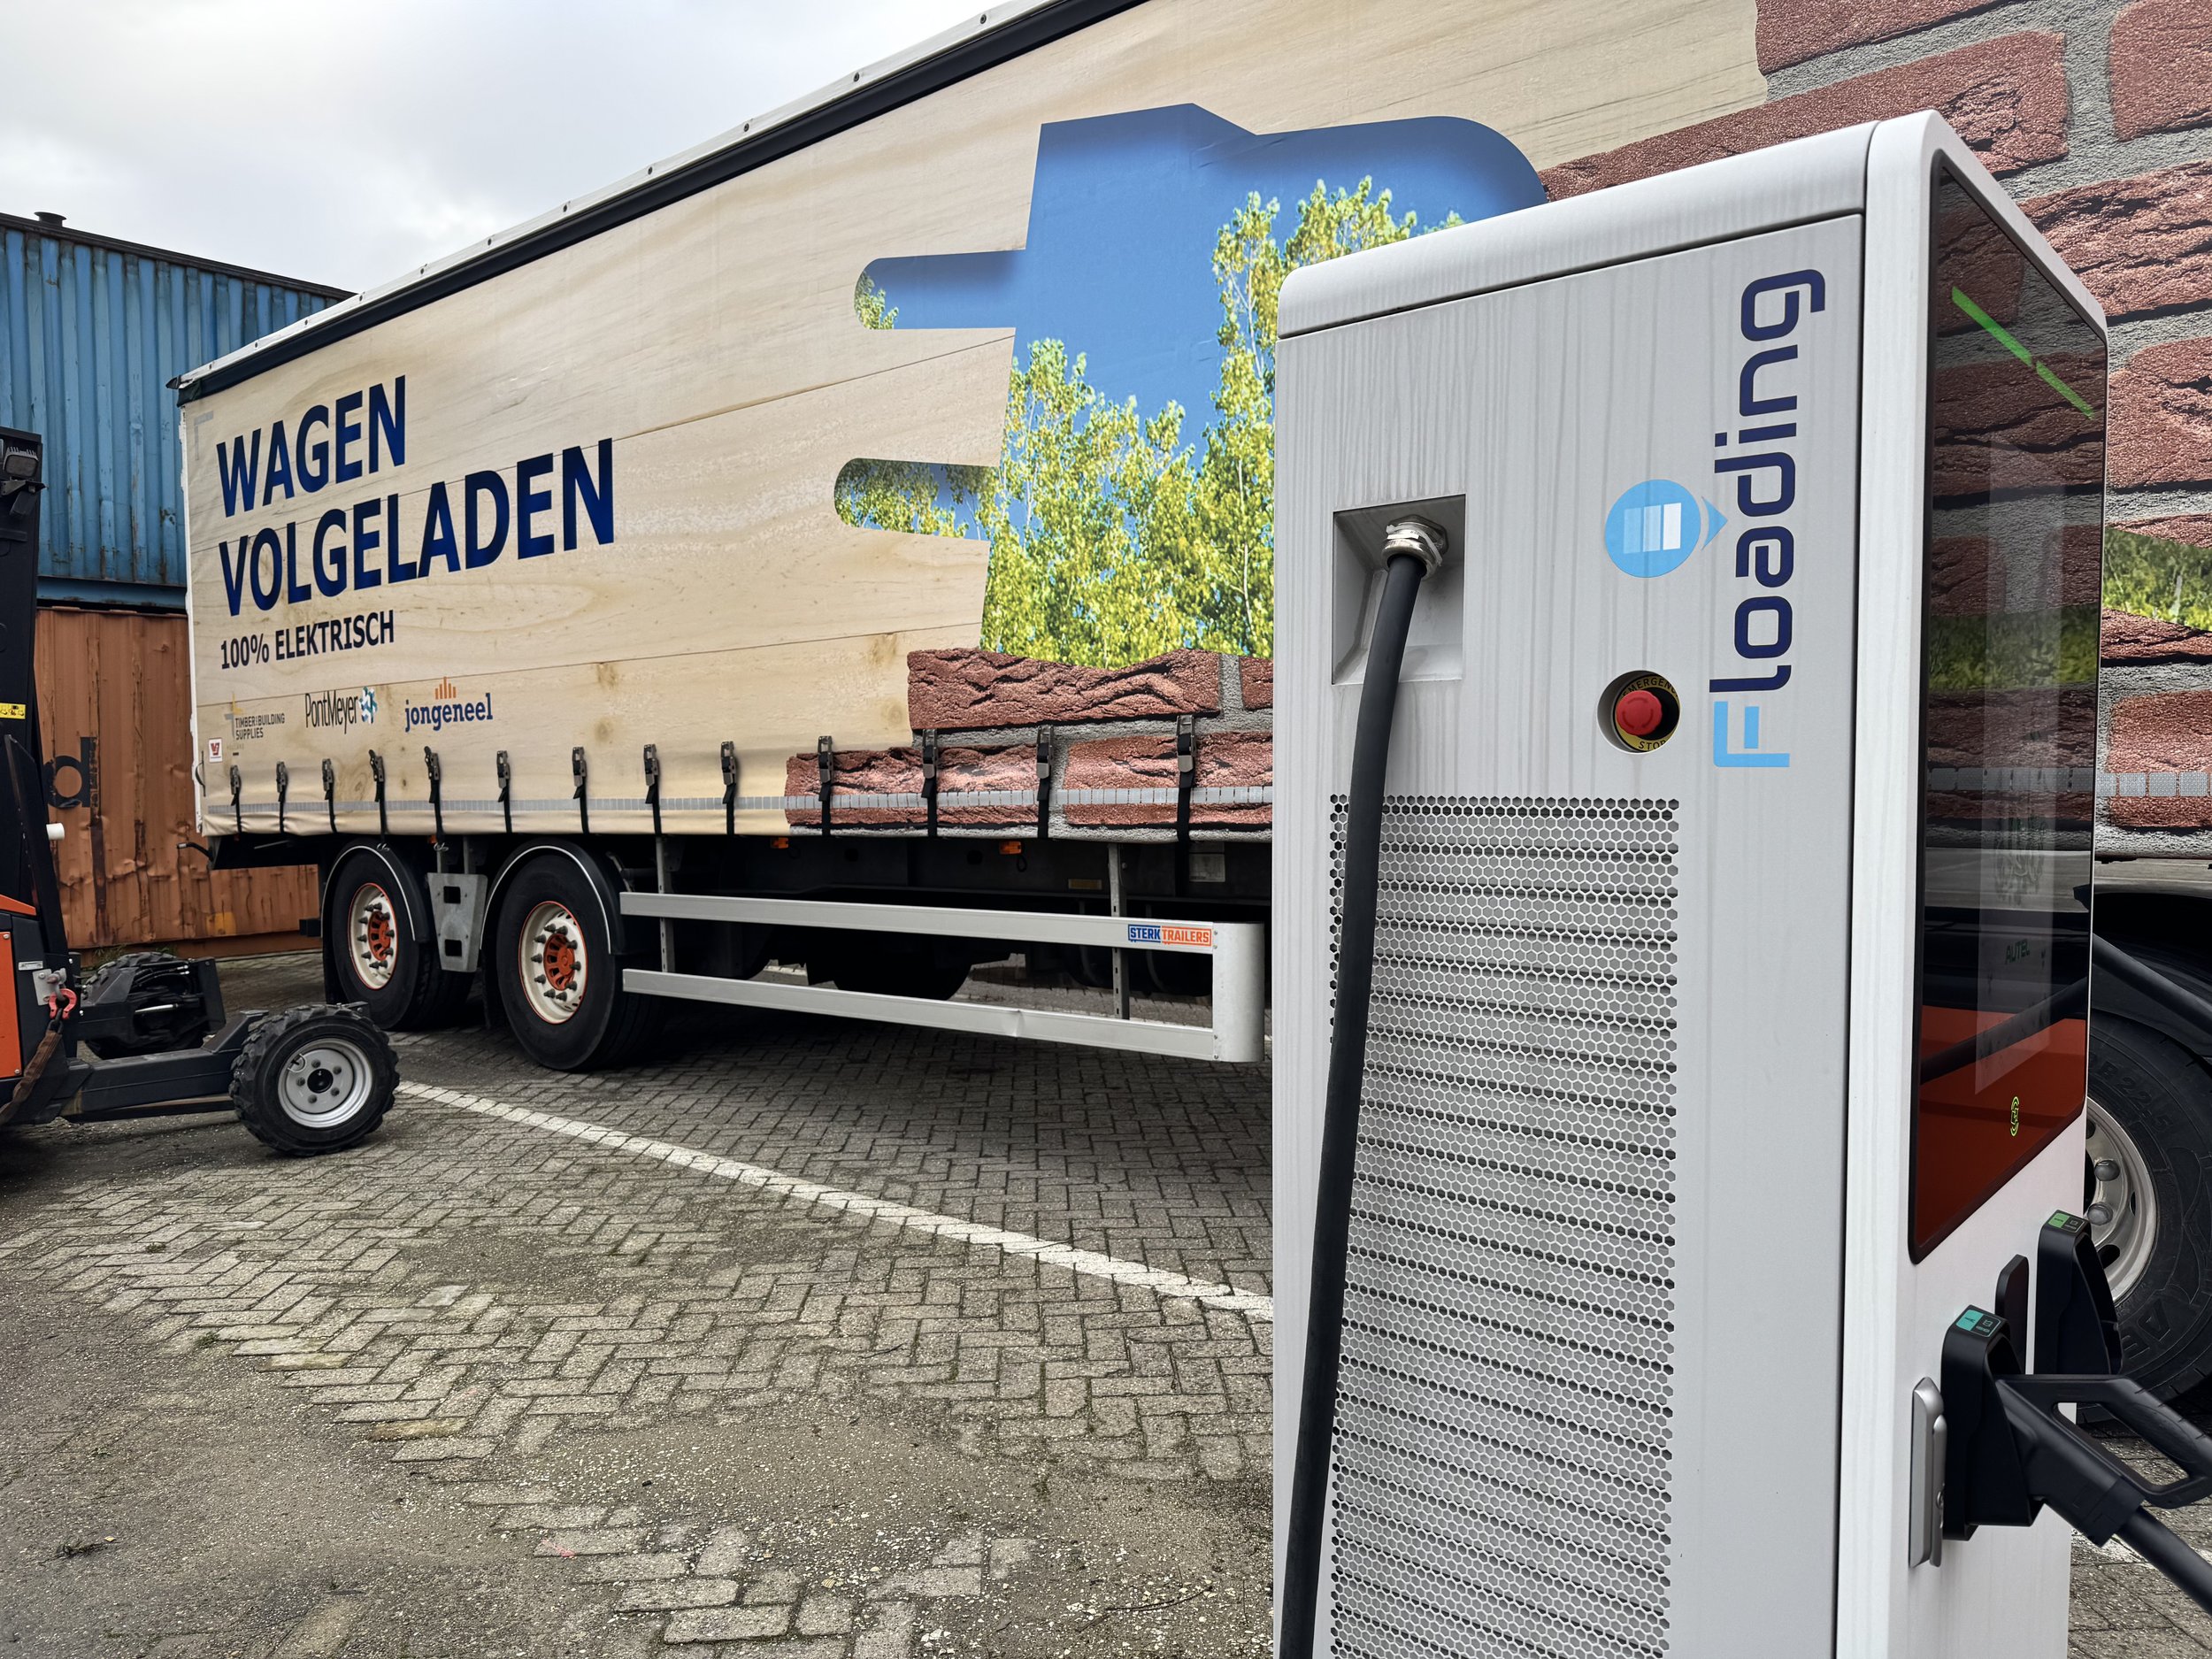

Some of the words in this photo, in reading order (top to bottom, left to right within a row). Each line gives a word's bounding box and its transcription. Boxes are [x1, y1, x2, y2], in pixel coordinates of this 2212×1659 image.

[217, 374, 406, 518] WAGEN
[219, 437, 615, 617] VOLGELADEN
[220, 633, 270, 670] 100%
[274, 610, 395, 662] ELEKTRISCH
[234, 716, 256, 728] TIMBER
[257, 712, 285, 726] BUILDING
[304, 691, 359, 734] PontMeyer
[404, 693, 494, 733] jongeneel
[235, 727, 264, 741] SUPPLIES
[1130, 926, 1161, 941] STERK
[1162, 930, 1210, 943] TRAILERS
